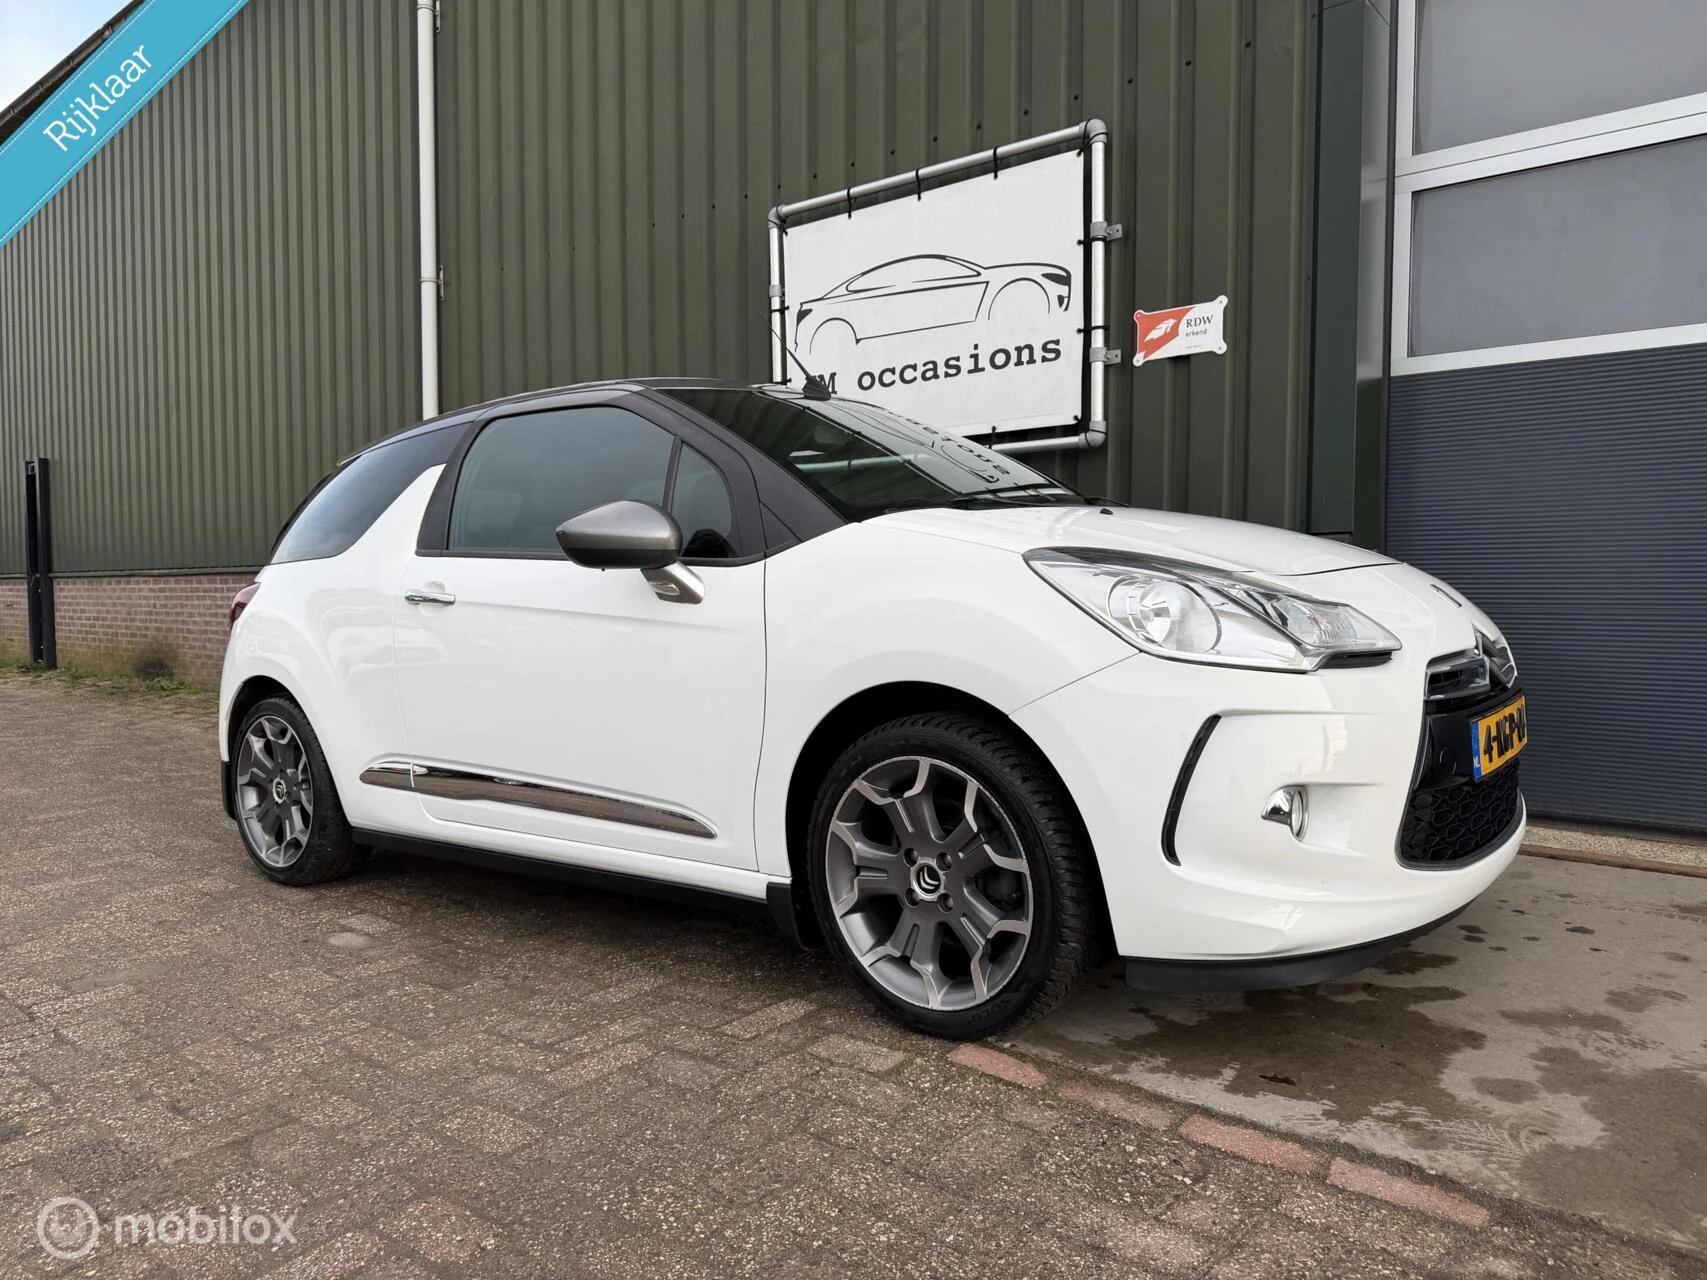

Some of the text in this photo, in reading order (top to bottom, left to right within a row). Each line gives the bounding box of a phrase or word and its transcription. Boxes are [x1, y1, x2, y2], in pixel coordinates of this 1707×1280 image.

[1186, 314, 1214, 328] RDW
[1185, 328, 1208, 338] erkend
[857, 338, 1062, 391] occasions
